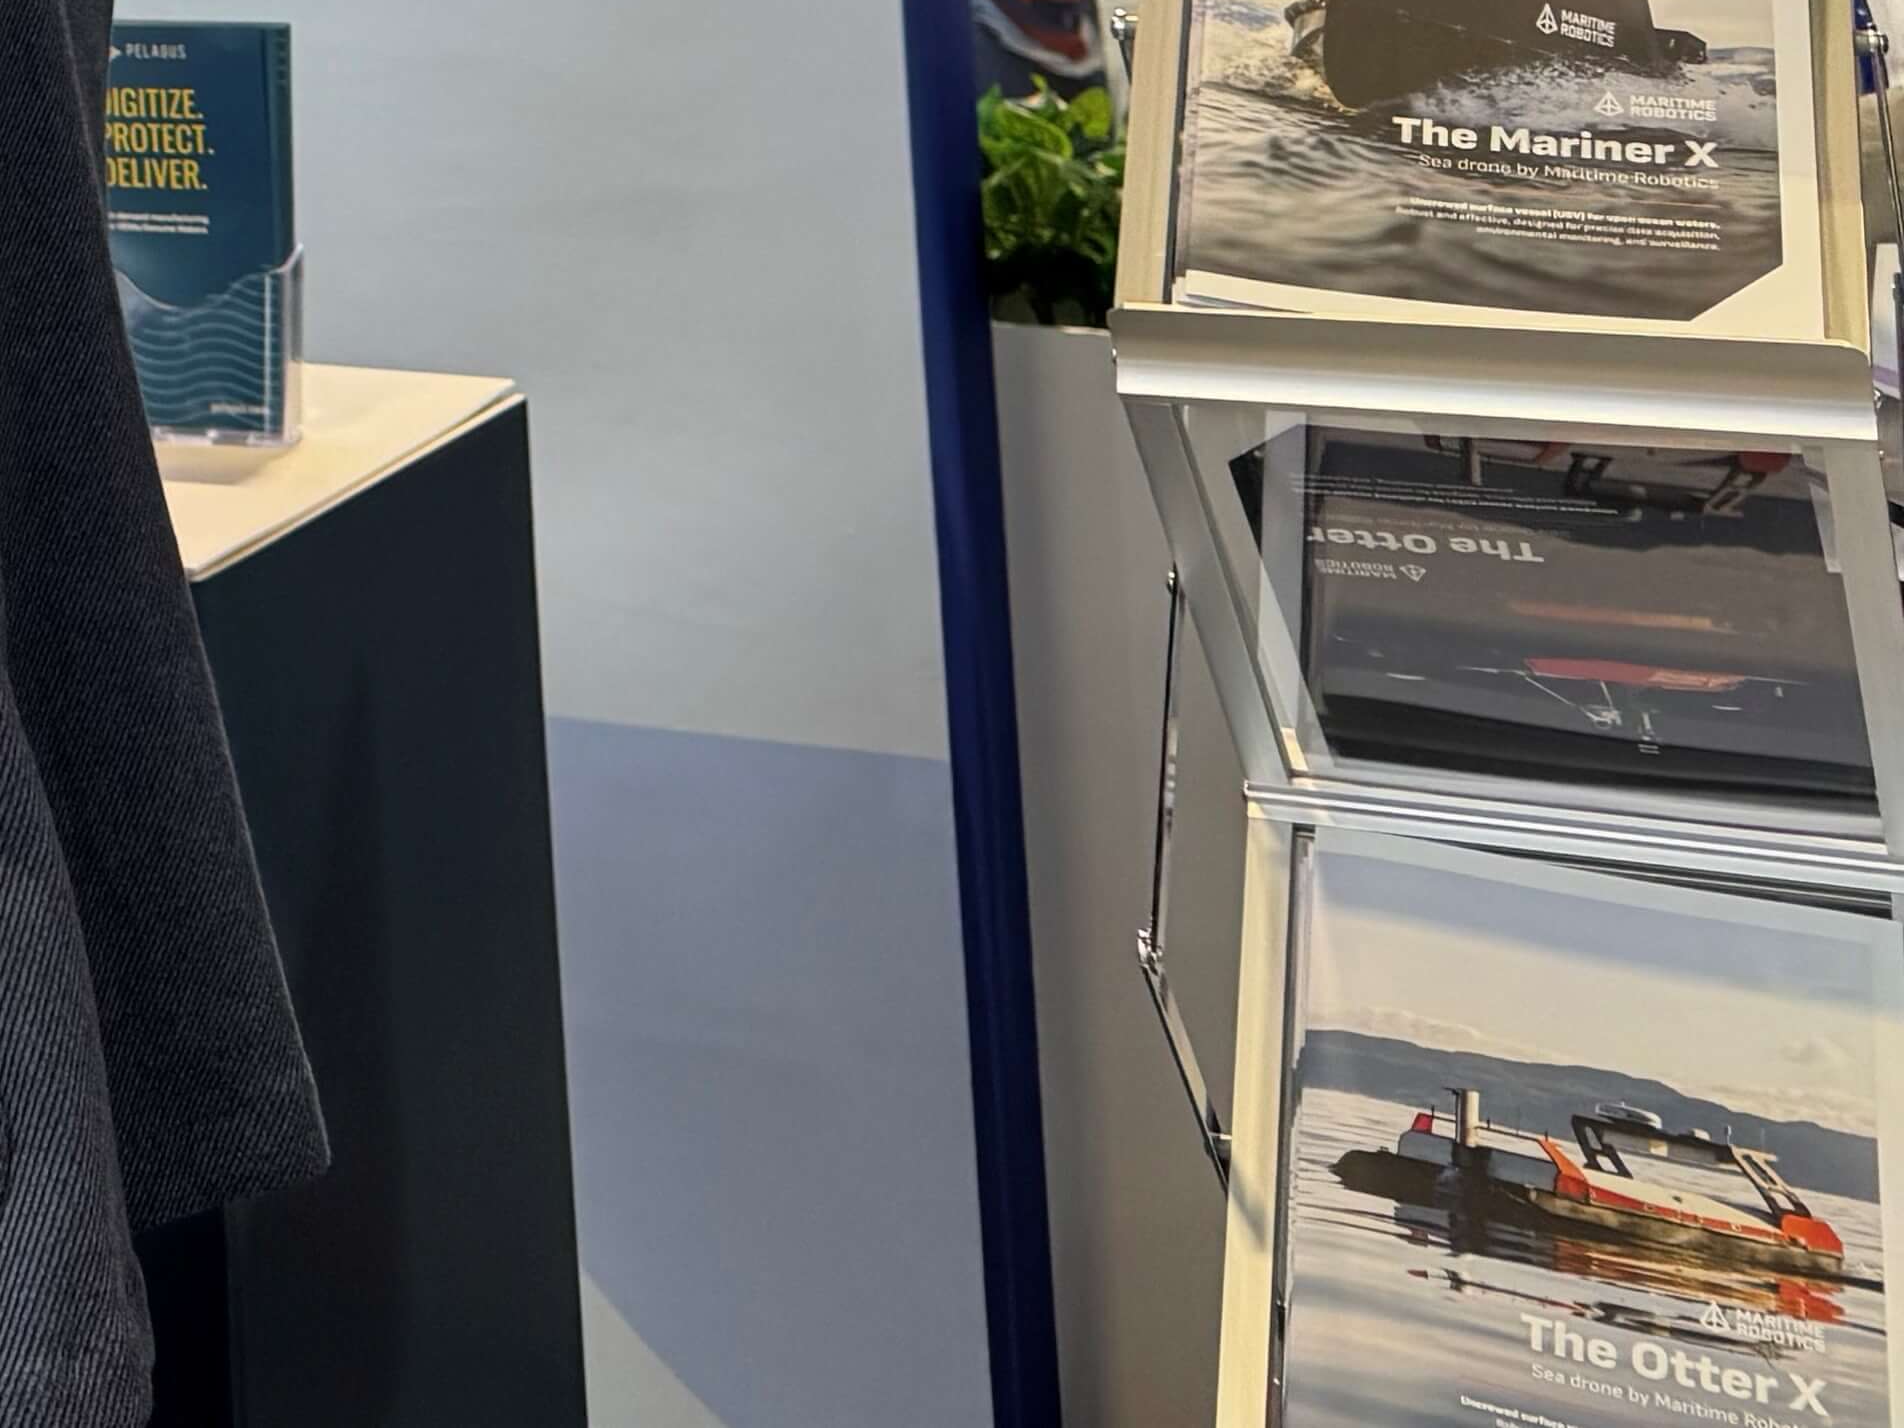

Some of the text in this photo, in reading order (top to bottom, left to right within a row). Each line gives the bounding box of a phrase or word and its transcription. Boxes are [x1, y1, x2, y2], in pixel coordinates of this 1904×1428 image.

[1560, 8, 1617, 35] MARITIME
[1560, 22, 1616, 49] ROBOTICS
[1629, 94, 1718, 112] MARITIME
[1629, 106, 1718, 122] ROBOTICS
[1392, 116, 1720, 168] The Mariner X
[106, 157, 209, 190] DELIVER.
[1418, 153, 1452, 169] Sea
[1458, 156, 1512, 176] drone
[1517, 161, 1539, 179] by
[1544, 165, 1629, 186] Maritime
[1305, 525, 1437, 555] Otter
[1448, 535, 1545, 563] The
[1735, 1307, 1826, 1339] MARITIME
[1735, 1323, 1827, 1354] ROBOTICS
[1520, 1313, 1830, 1418] The Otter X
[1531, 1362, 1566, 1385] Sea
[1568, 1371, 1624, 1399] drone
[1627, 1383, 1651, 1407] by
[1654, 1390, 1740, 1428] Maritime
